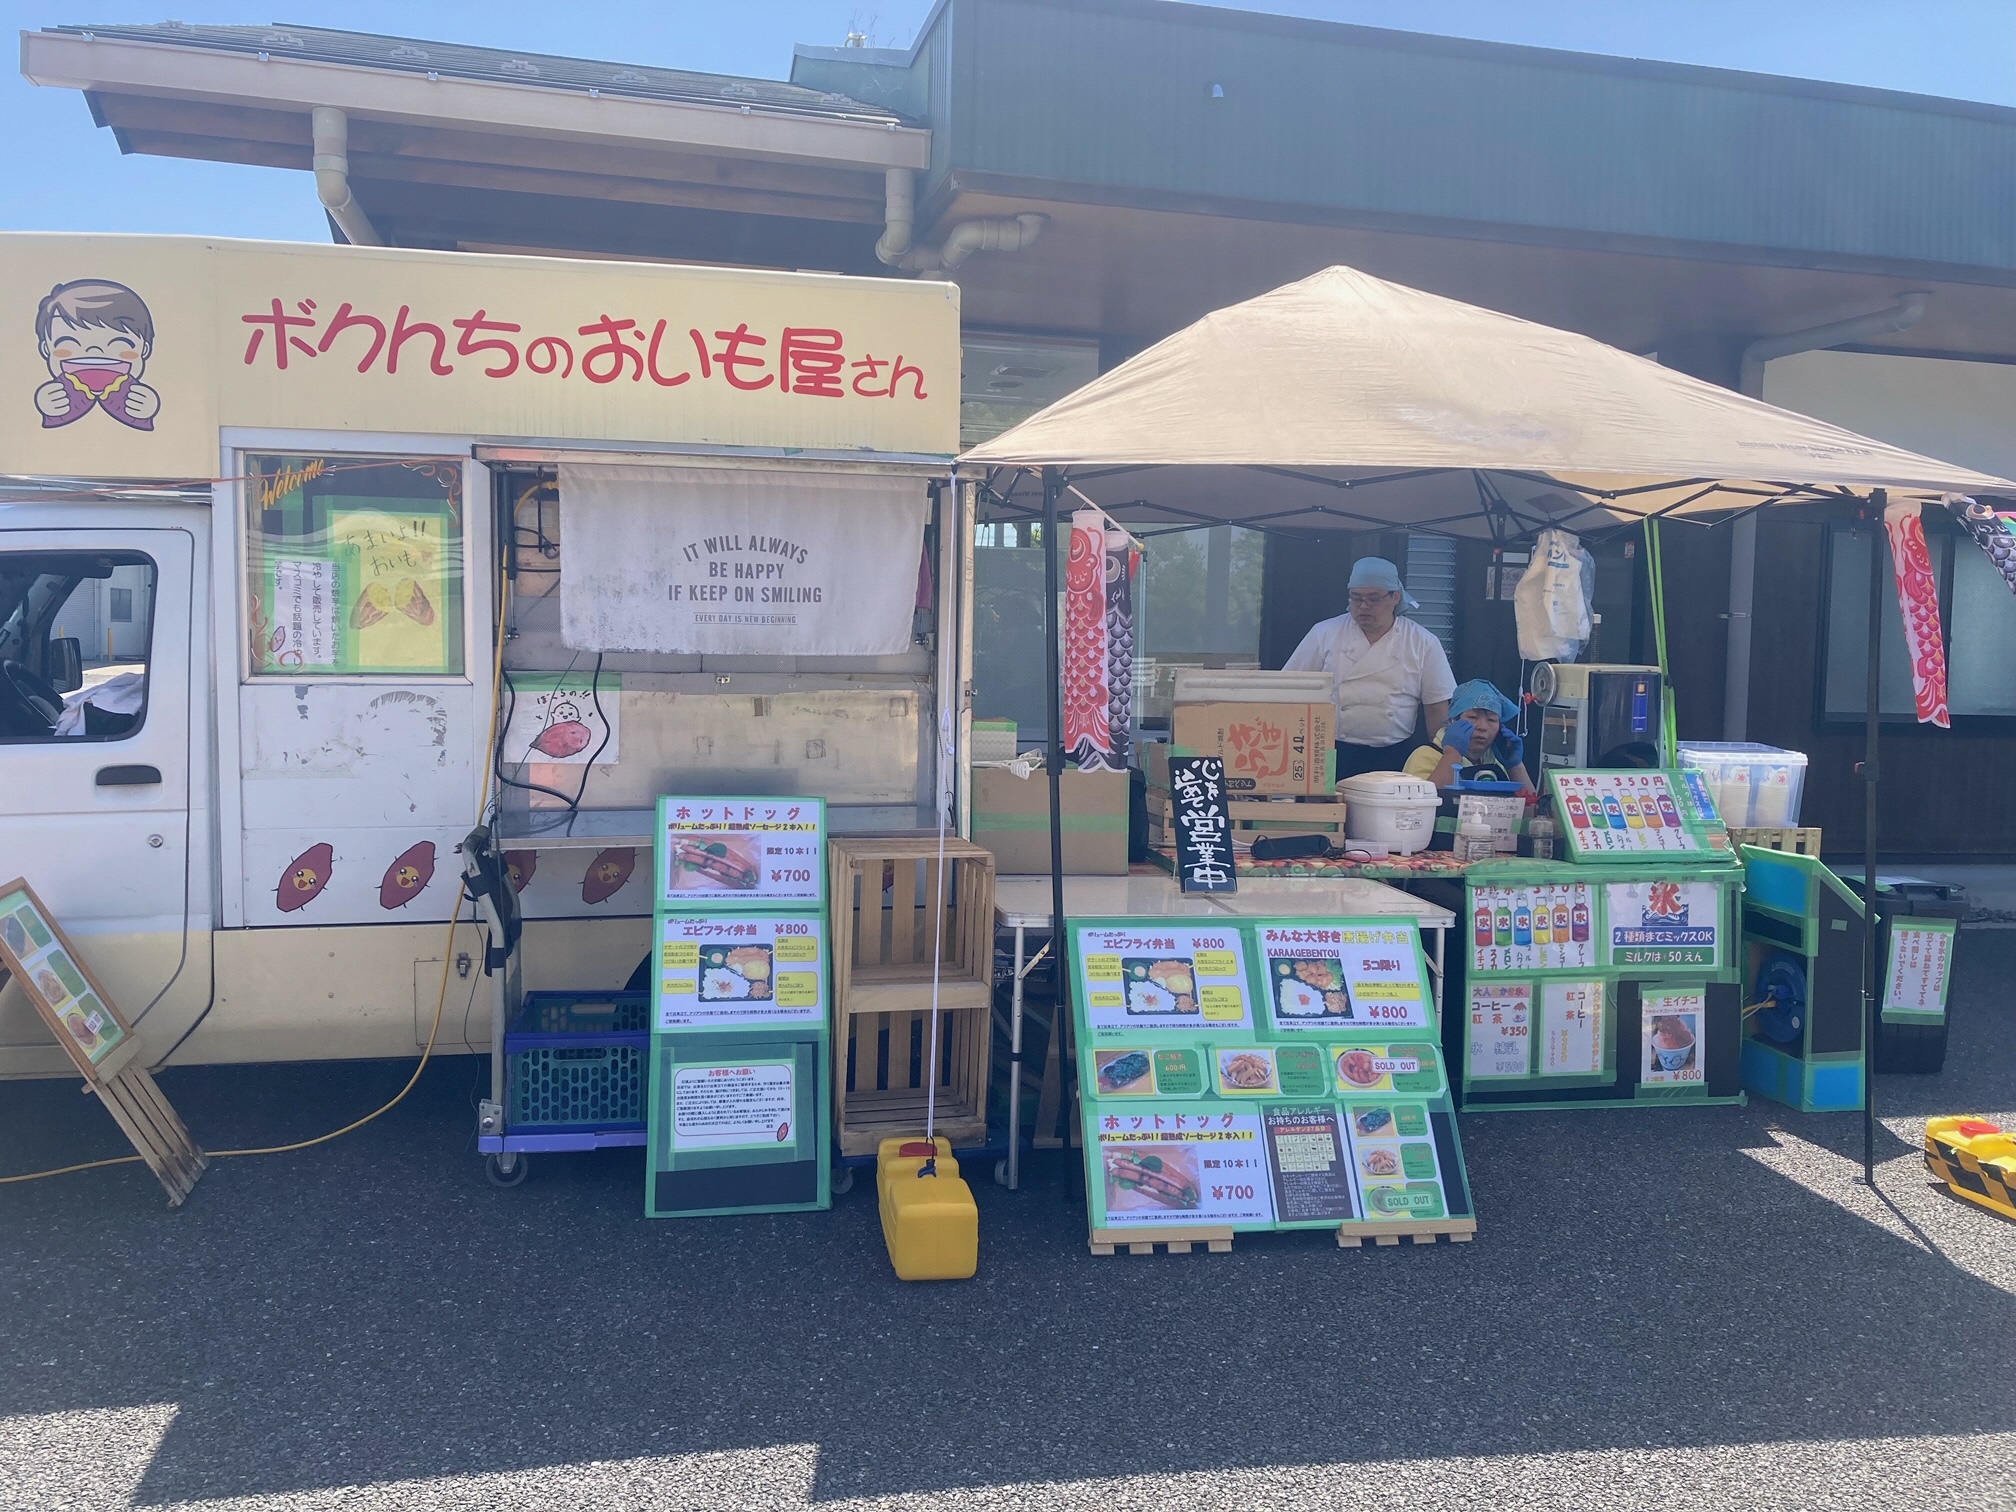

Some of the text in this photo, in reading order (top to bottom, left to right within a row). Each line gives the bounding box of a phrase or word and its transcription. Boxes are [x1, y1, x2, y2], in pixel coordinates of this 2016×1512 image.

[259, 458, 326, 511] Welcome
[683, 535, 808, 564] IT WILL ALWAYS
[709, 561, 784, 579] BE HAPPY
[668, 584, 822, 603] IF KEEP ON SMILING
[695, 614, 716, 622] EVERY
[718, 614, 732, 622] DAY
[734, 615, 742, 623] IS
[744, 615, 759, 623] NEW
[1559, 776, 1665, 787] かき氷 350円
[676, 806, 801, 820] ホットドッグ
[1180, 804, 1231, 890] 営業中
[771, 869, 811, 882] ¥700
[1648, 882, 1683, 915] 氷
[683, 924, 808, 936] エビフライ弁当 ¥800
[1103, 938, 1225, 949] エビフライ弁当 ¥800
[1267, 948, 1340, 958] KARAAGEBENTOU
[1362, 959, 1401, 971] 5コ限り
[1369, 1005, 1407, 1019] ¥800
[1472, 1001, 1511, 1011] コーヒー
[1577, 992, 1586, 1028] コーヒー
[1501, 1026, 1528, 1036] ¥350
[1374, 1061, 1416, 1070] SOLD OUT
[708, 1068, 756, 1077] お客様へお願い
[1673, 1070, 1701, 1080] ¥800
[1272, 1106, 1330, 1116] 食品アレルギー
[1104, 1112, 1235, 1130] ホットドッグ
[1268, 1115, 1335, 1126] お持ちのお客様へ
[1211, 1185, 1255, 1200] ¥700
[1388, 1195, 1430, 1206] SOLD OUT
